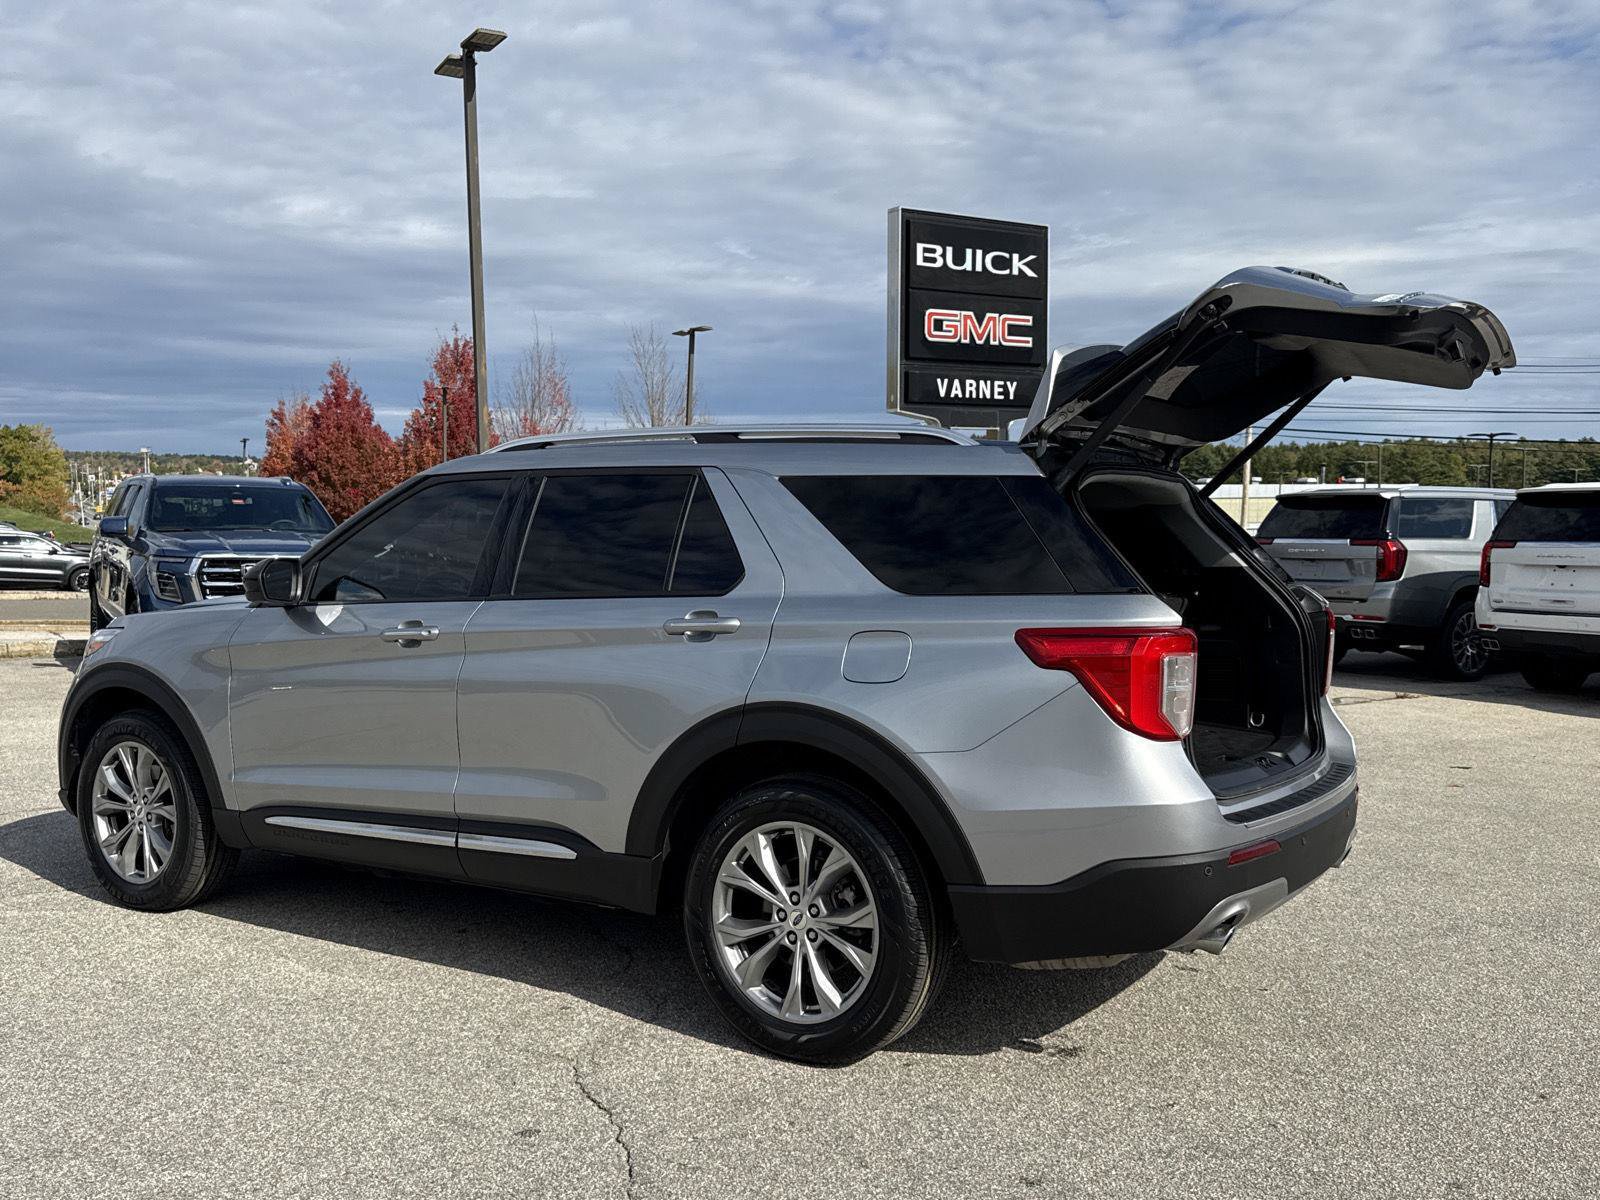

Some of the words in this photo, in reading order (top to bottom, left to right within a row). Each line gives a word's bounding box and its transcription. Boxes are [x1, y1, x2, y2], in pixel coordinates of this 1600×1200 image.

[916, 242, 1038, 277] BUICK
[925, 308, 1033, 347] GMC
[936, 378, 1017, 400] VARNEY
